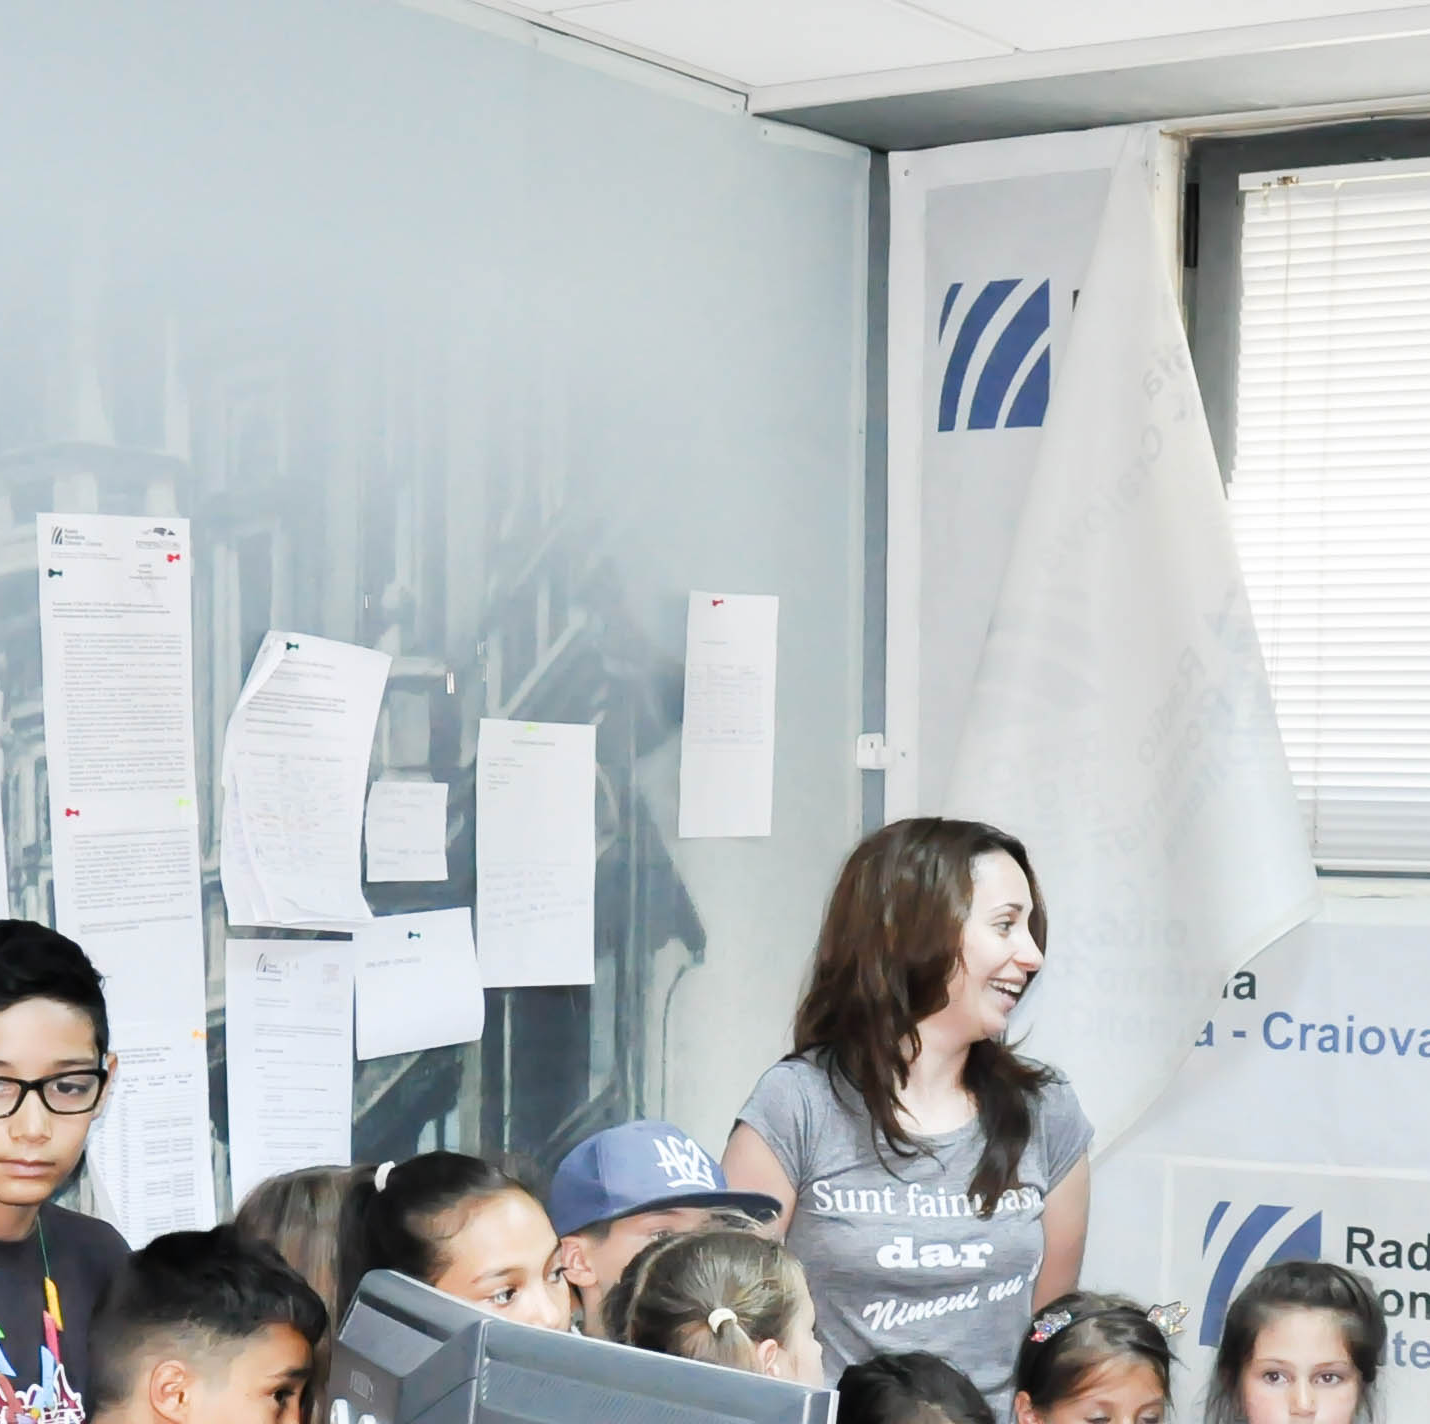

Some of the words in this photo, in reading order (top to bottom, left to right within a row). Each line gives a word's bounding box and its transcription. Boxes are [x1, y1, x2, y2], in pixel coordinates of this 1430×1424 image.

[811, 1179, 898, 1216] Sunt
[875, 1236, 995, 1269] dar
[862, 1285, 980, 1331] Nimeni
